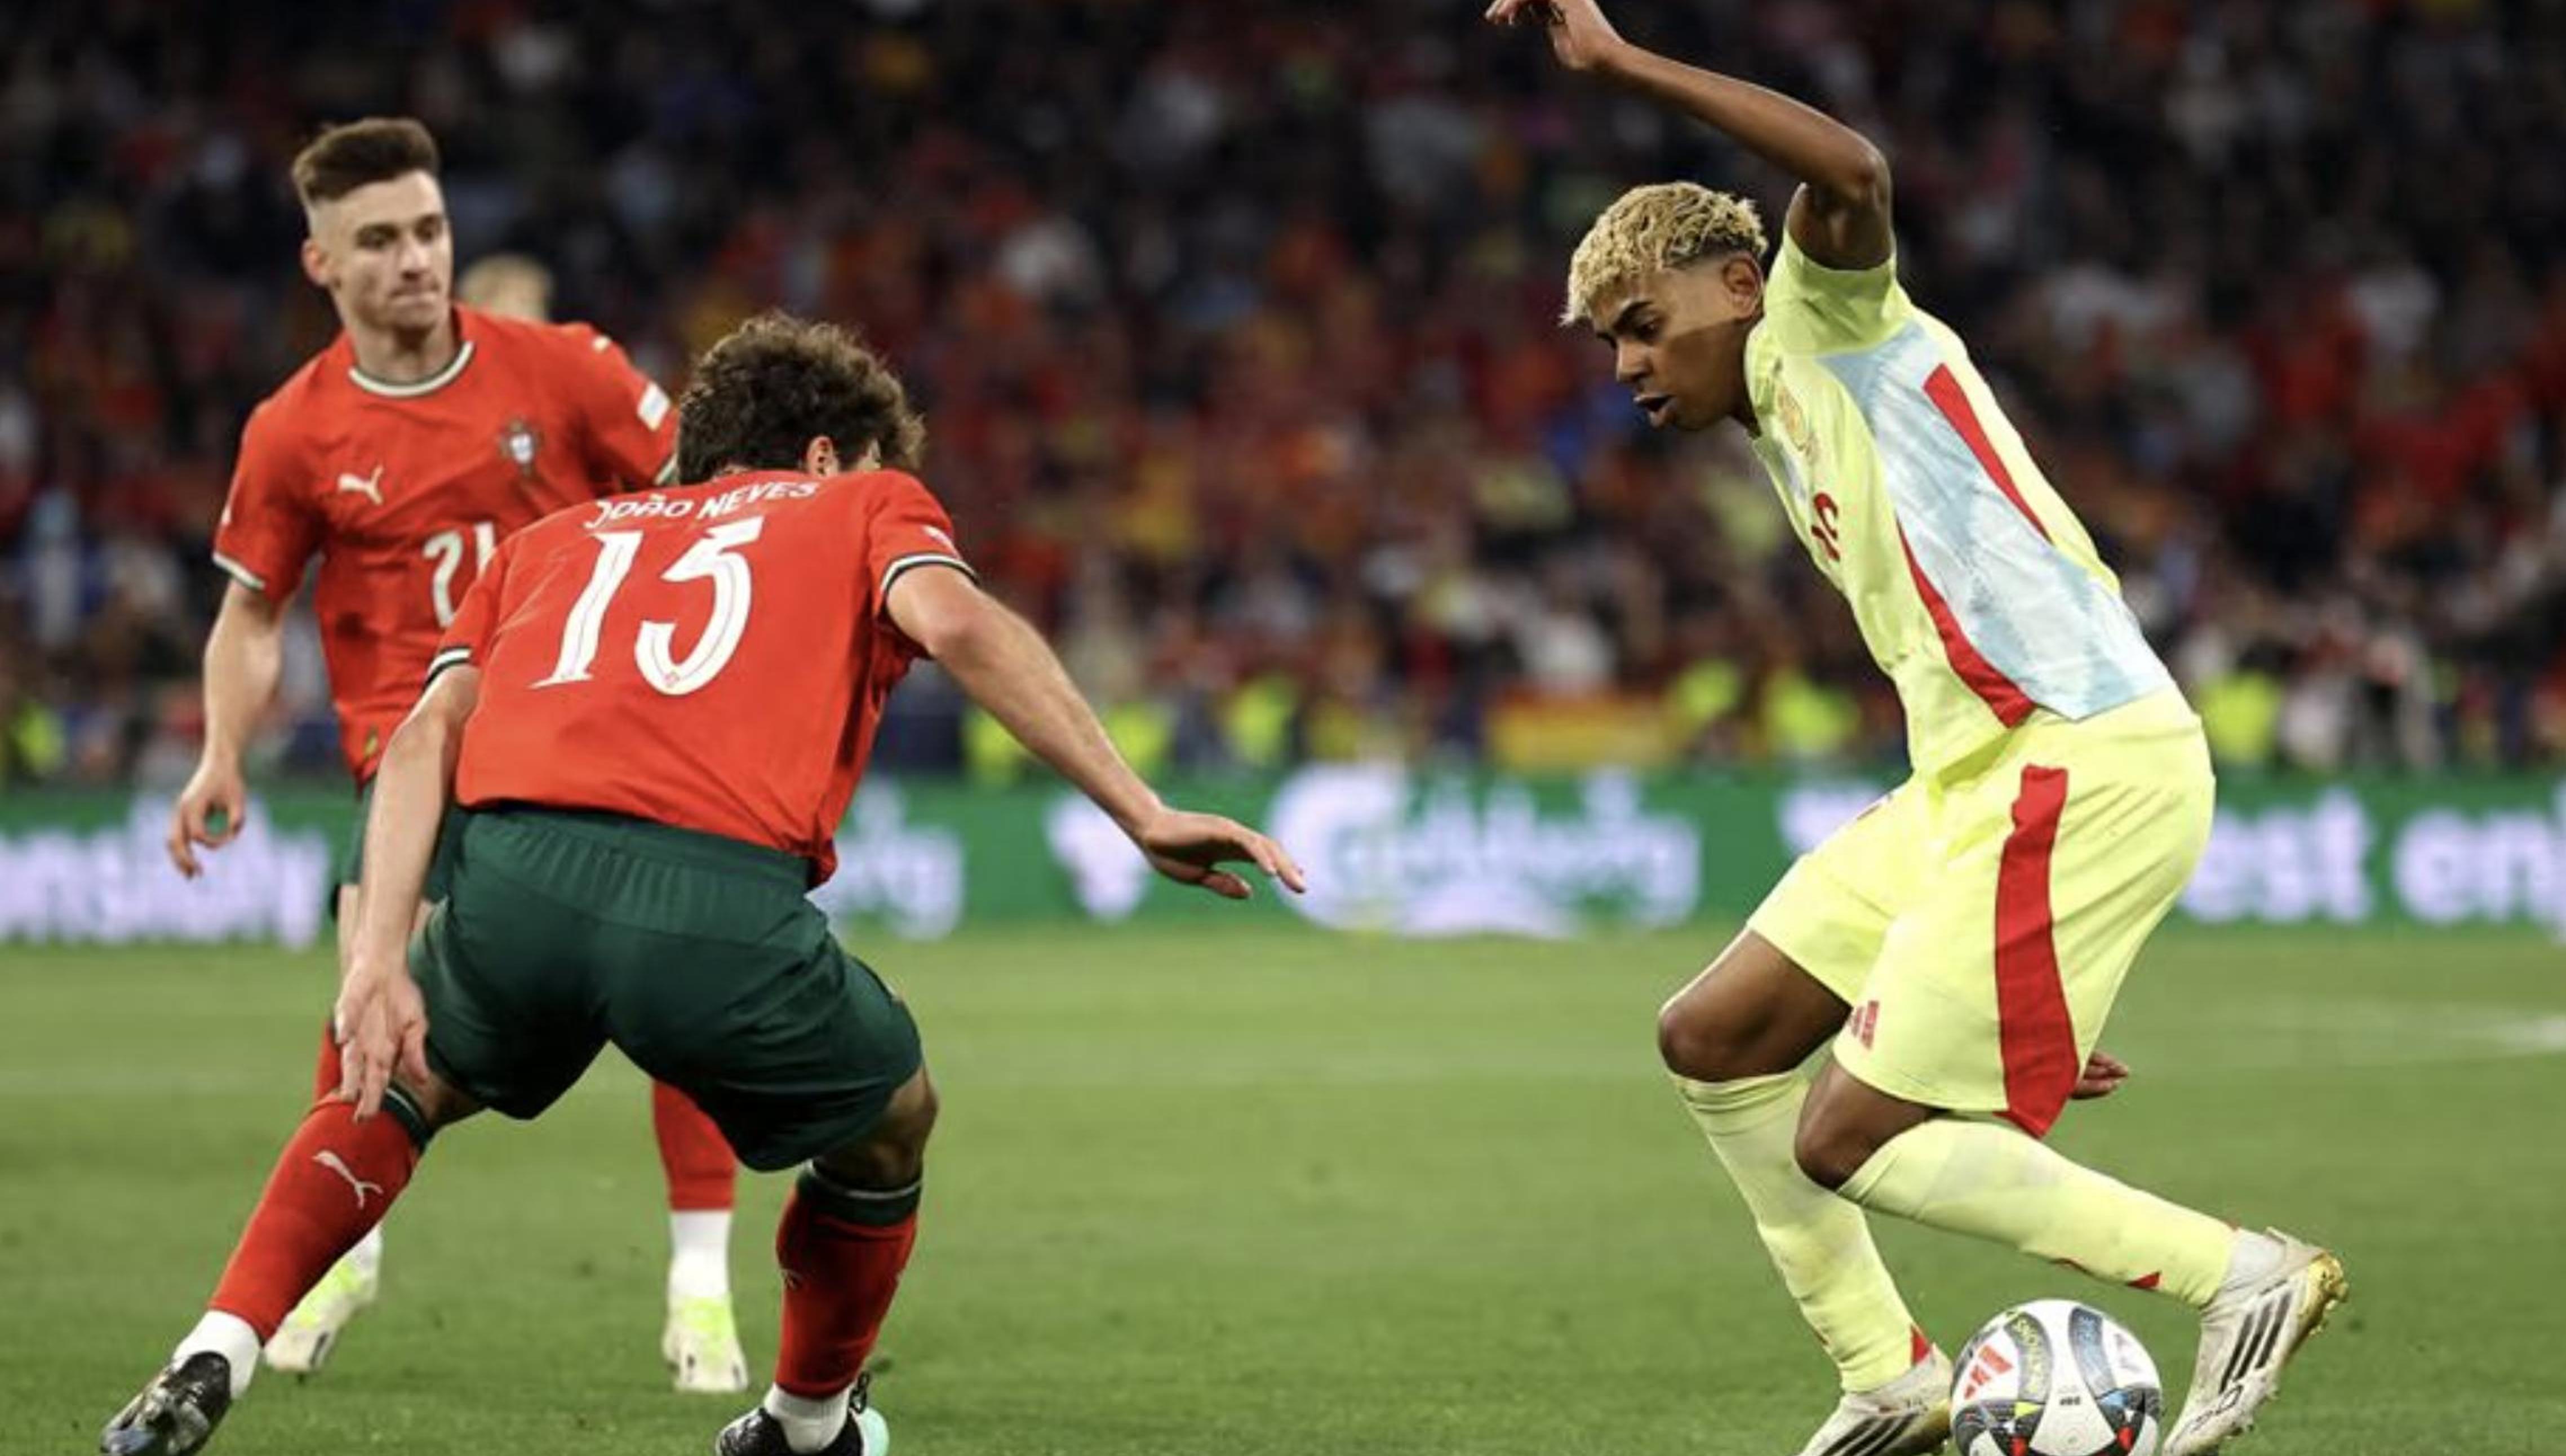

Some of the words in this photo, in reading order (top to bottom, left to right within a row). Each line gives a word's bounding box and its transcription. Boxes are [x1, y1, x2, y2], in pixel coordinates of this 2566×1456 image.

[584, 494, 694, 528] JOÃO
[696, 482, 819, 519] NEVES
[531, 516, 765, 695] 15
